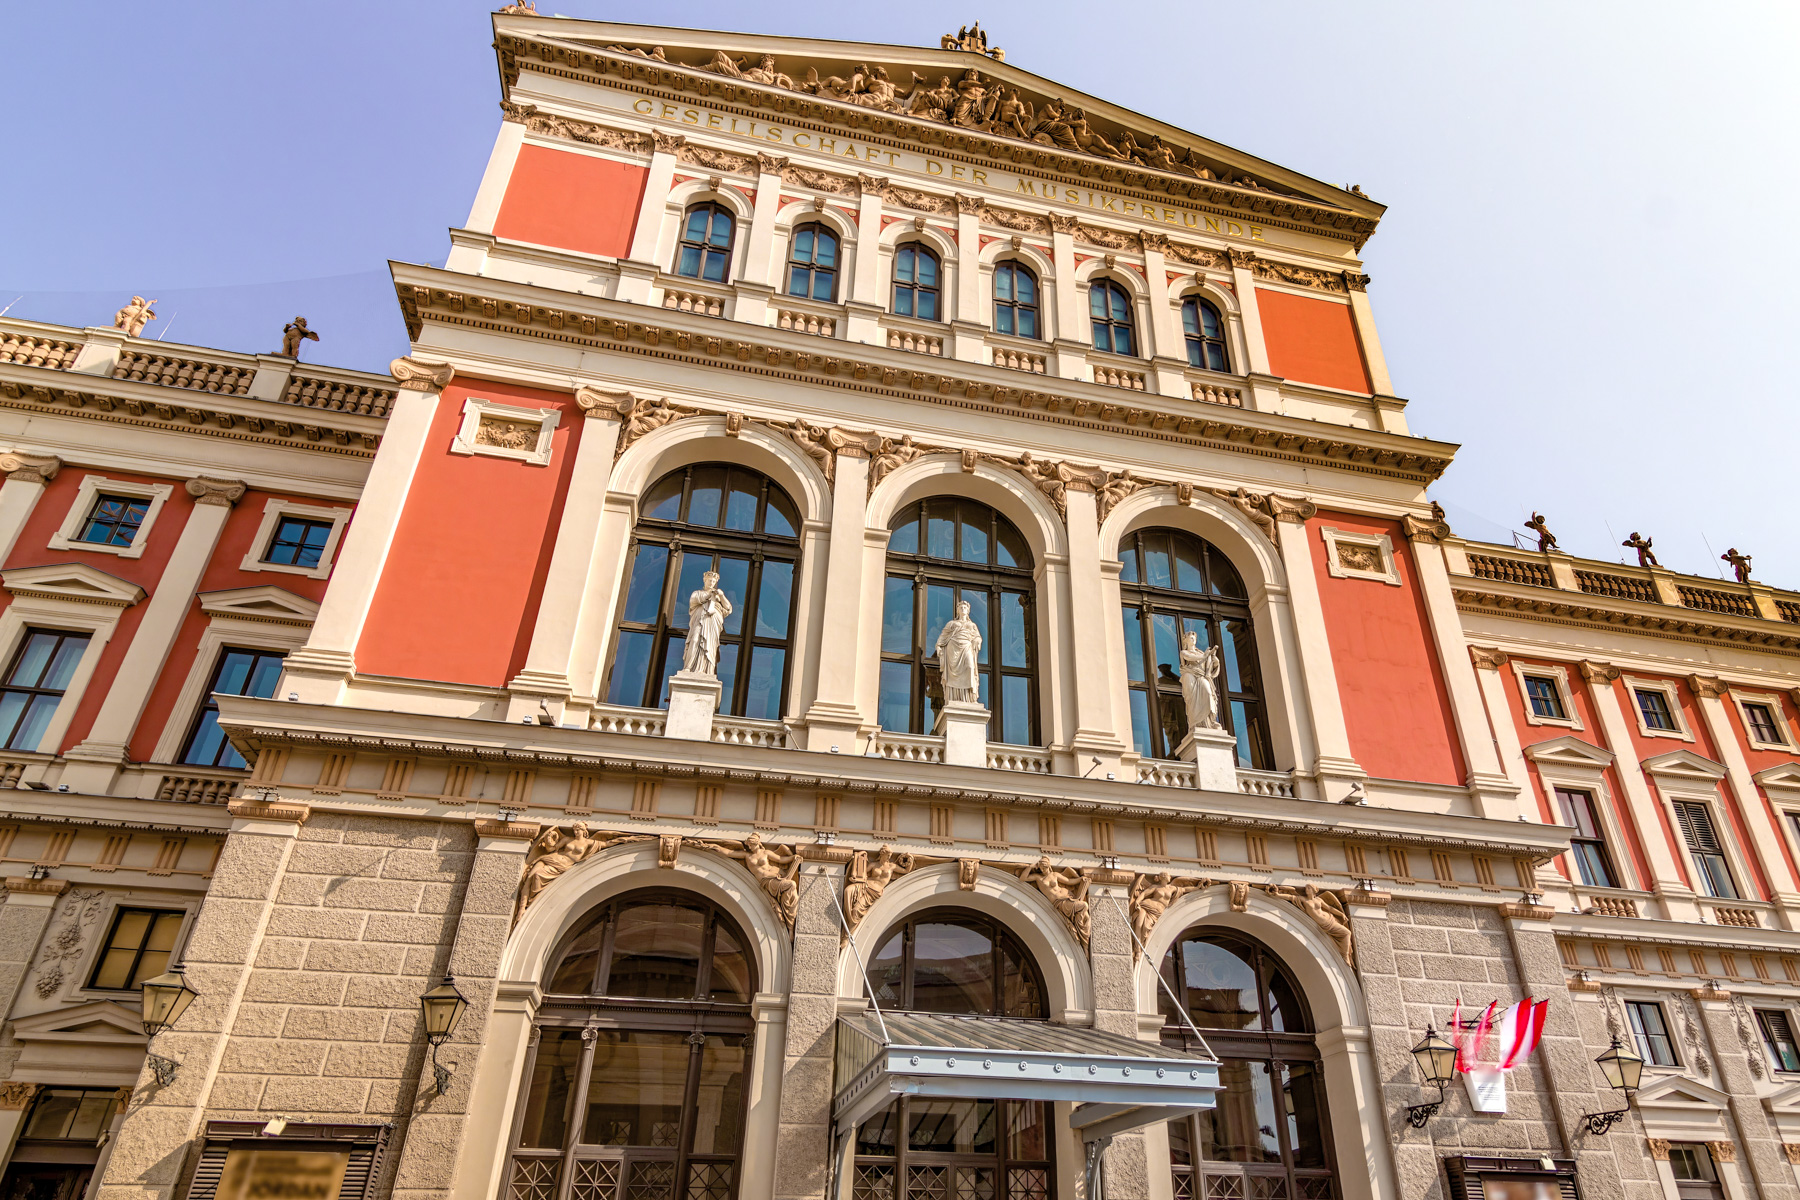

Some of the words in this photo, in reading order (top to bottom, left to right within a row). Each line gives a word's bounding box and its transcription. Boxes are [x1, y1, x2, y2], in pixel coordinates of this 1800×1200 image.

[633, 98, 902, 167] GESELLSCHAFT
[925, 159, 989, 186] DER
[1015, 178, 1266, 242] MUSIKFREUNDE
